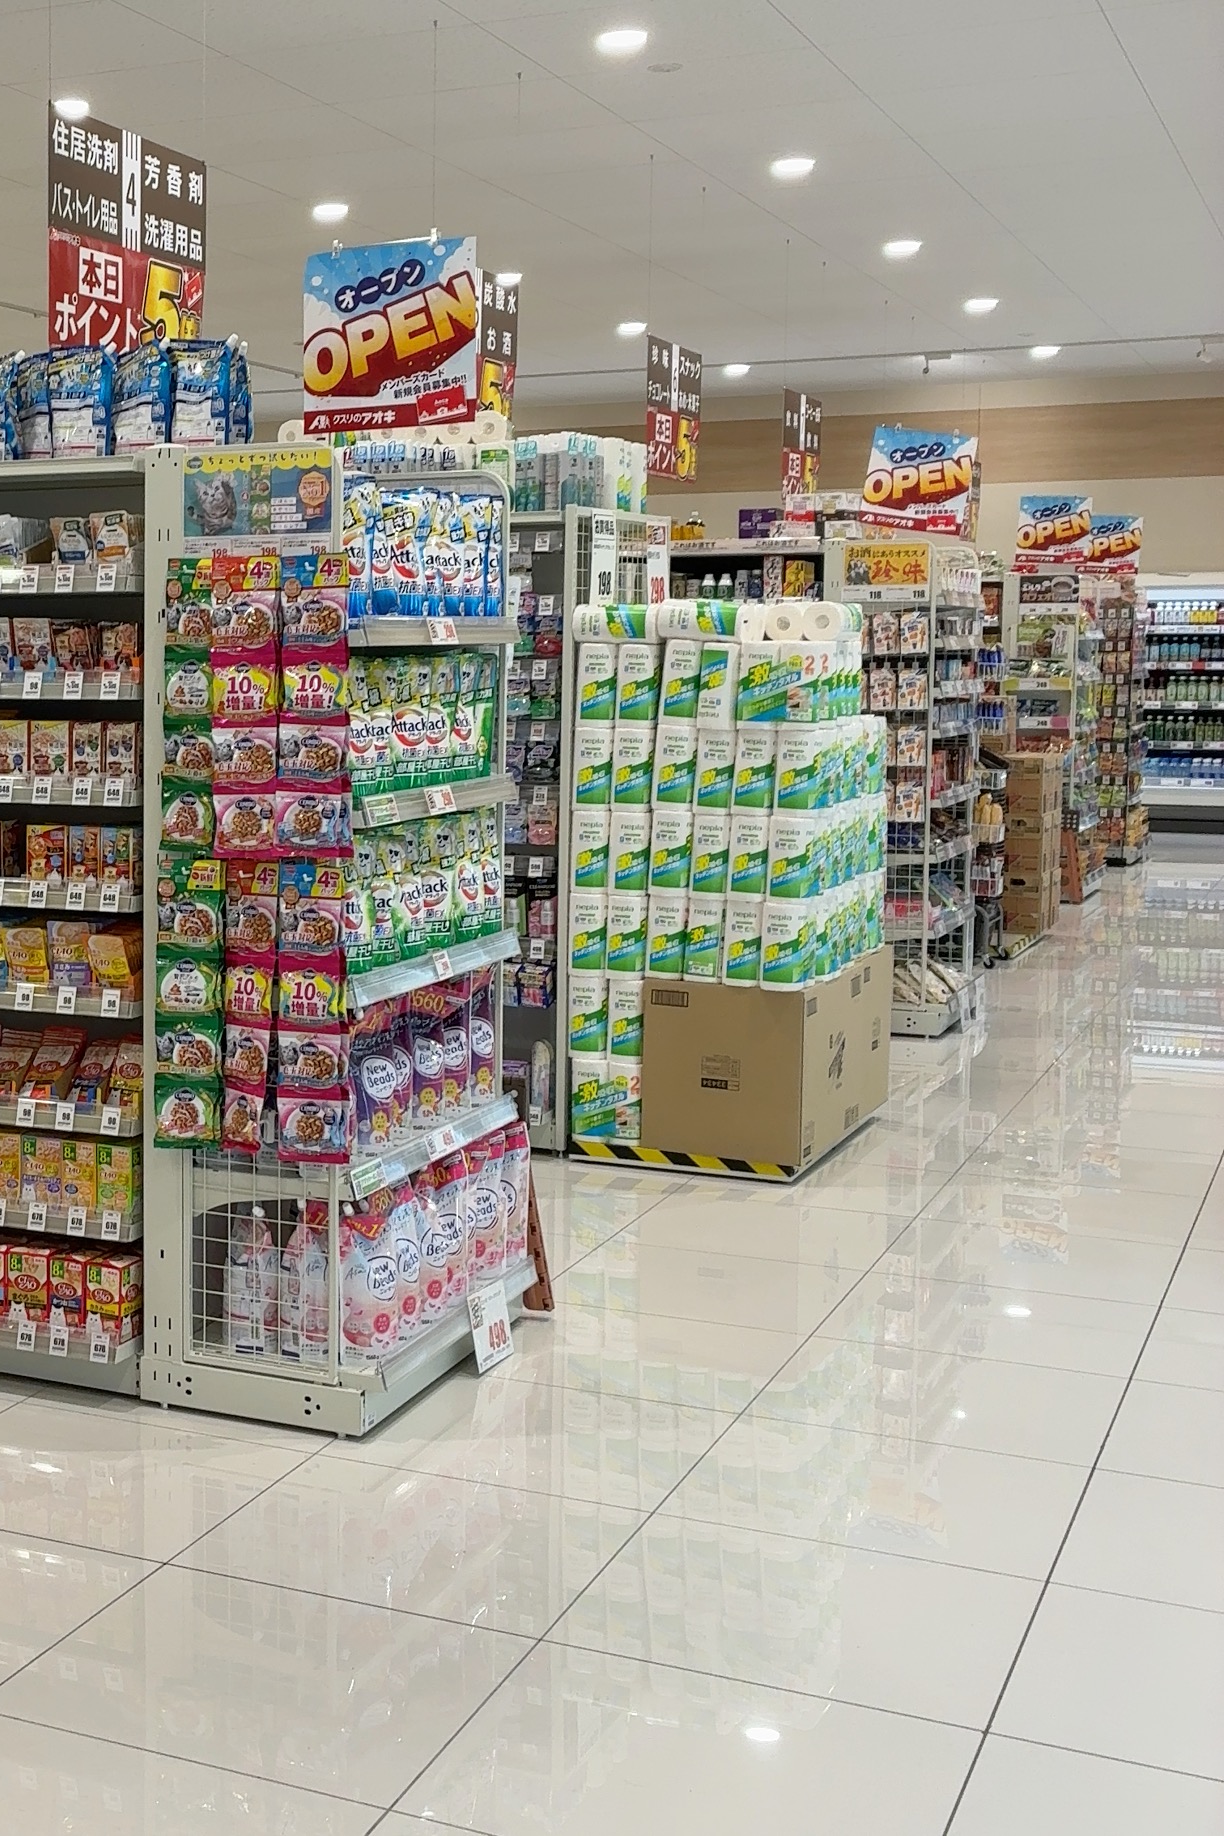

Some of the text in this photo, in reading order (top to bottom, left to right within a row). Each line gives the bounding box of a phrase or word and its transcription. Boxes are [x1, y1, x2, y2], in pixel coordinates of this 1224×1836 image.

[52, 118, 119, 176] 住居洗剤
[144, 154, 203, 206] 芳香剤
[126, 173, 137, 218] 4
[144, 213, 202, 262] 洗濯用品
[82, 253, 121, 300] 本日
[337, 264, 421, 310] オープン
[304, 275, 477, 393] OPEN
[380, 368, 445, 392] メンバーズカード
[333, 410, 396, 424] クスリのアオキ
[207, 451, 319, 466] ちょっとずつ試したい!
[891, 444, 945, 462] オープン
[863, 455, 973, 503] OPEN
[1017, 509, 1091, 549] OPEN
[597, 570, 612, 596] 198
[871, 560, 927, 584] 珍味
[227, 673, 265, 696] 10%
[297, 673, 334, 695] 10%
[225, 694, 264, 711] 増量!
[294, 691, 334, 710] 増量!
[391, 715, 427, 735] Attack
[366, 1063, 389, 1077] New
[366, 1072, 396, 1092] Beads
[489, 1321, 510, 1352] 498
